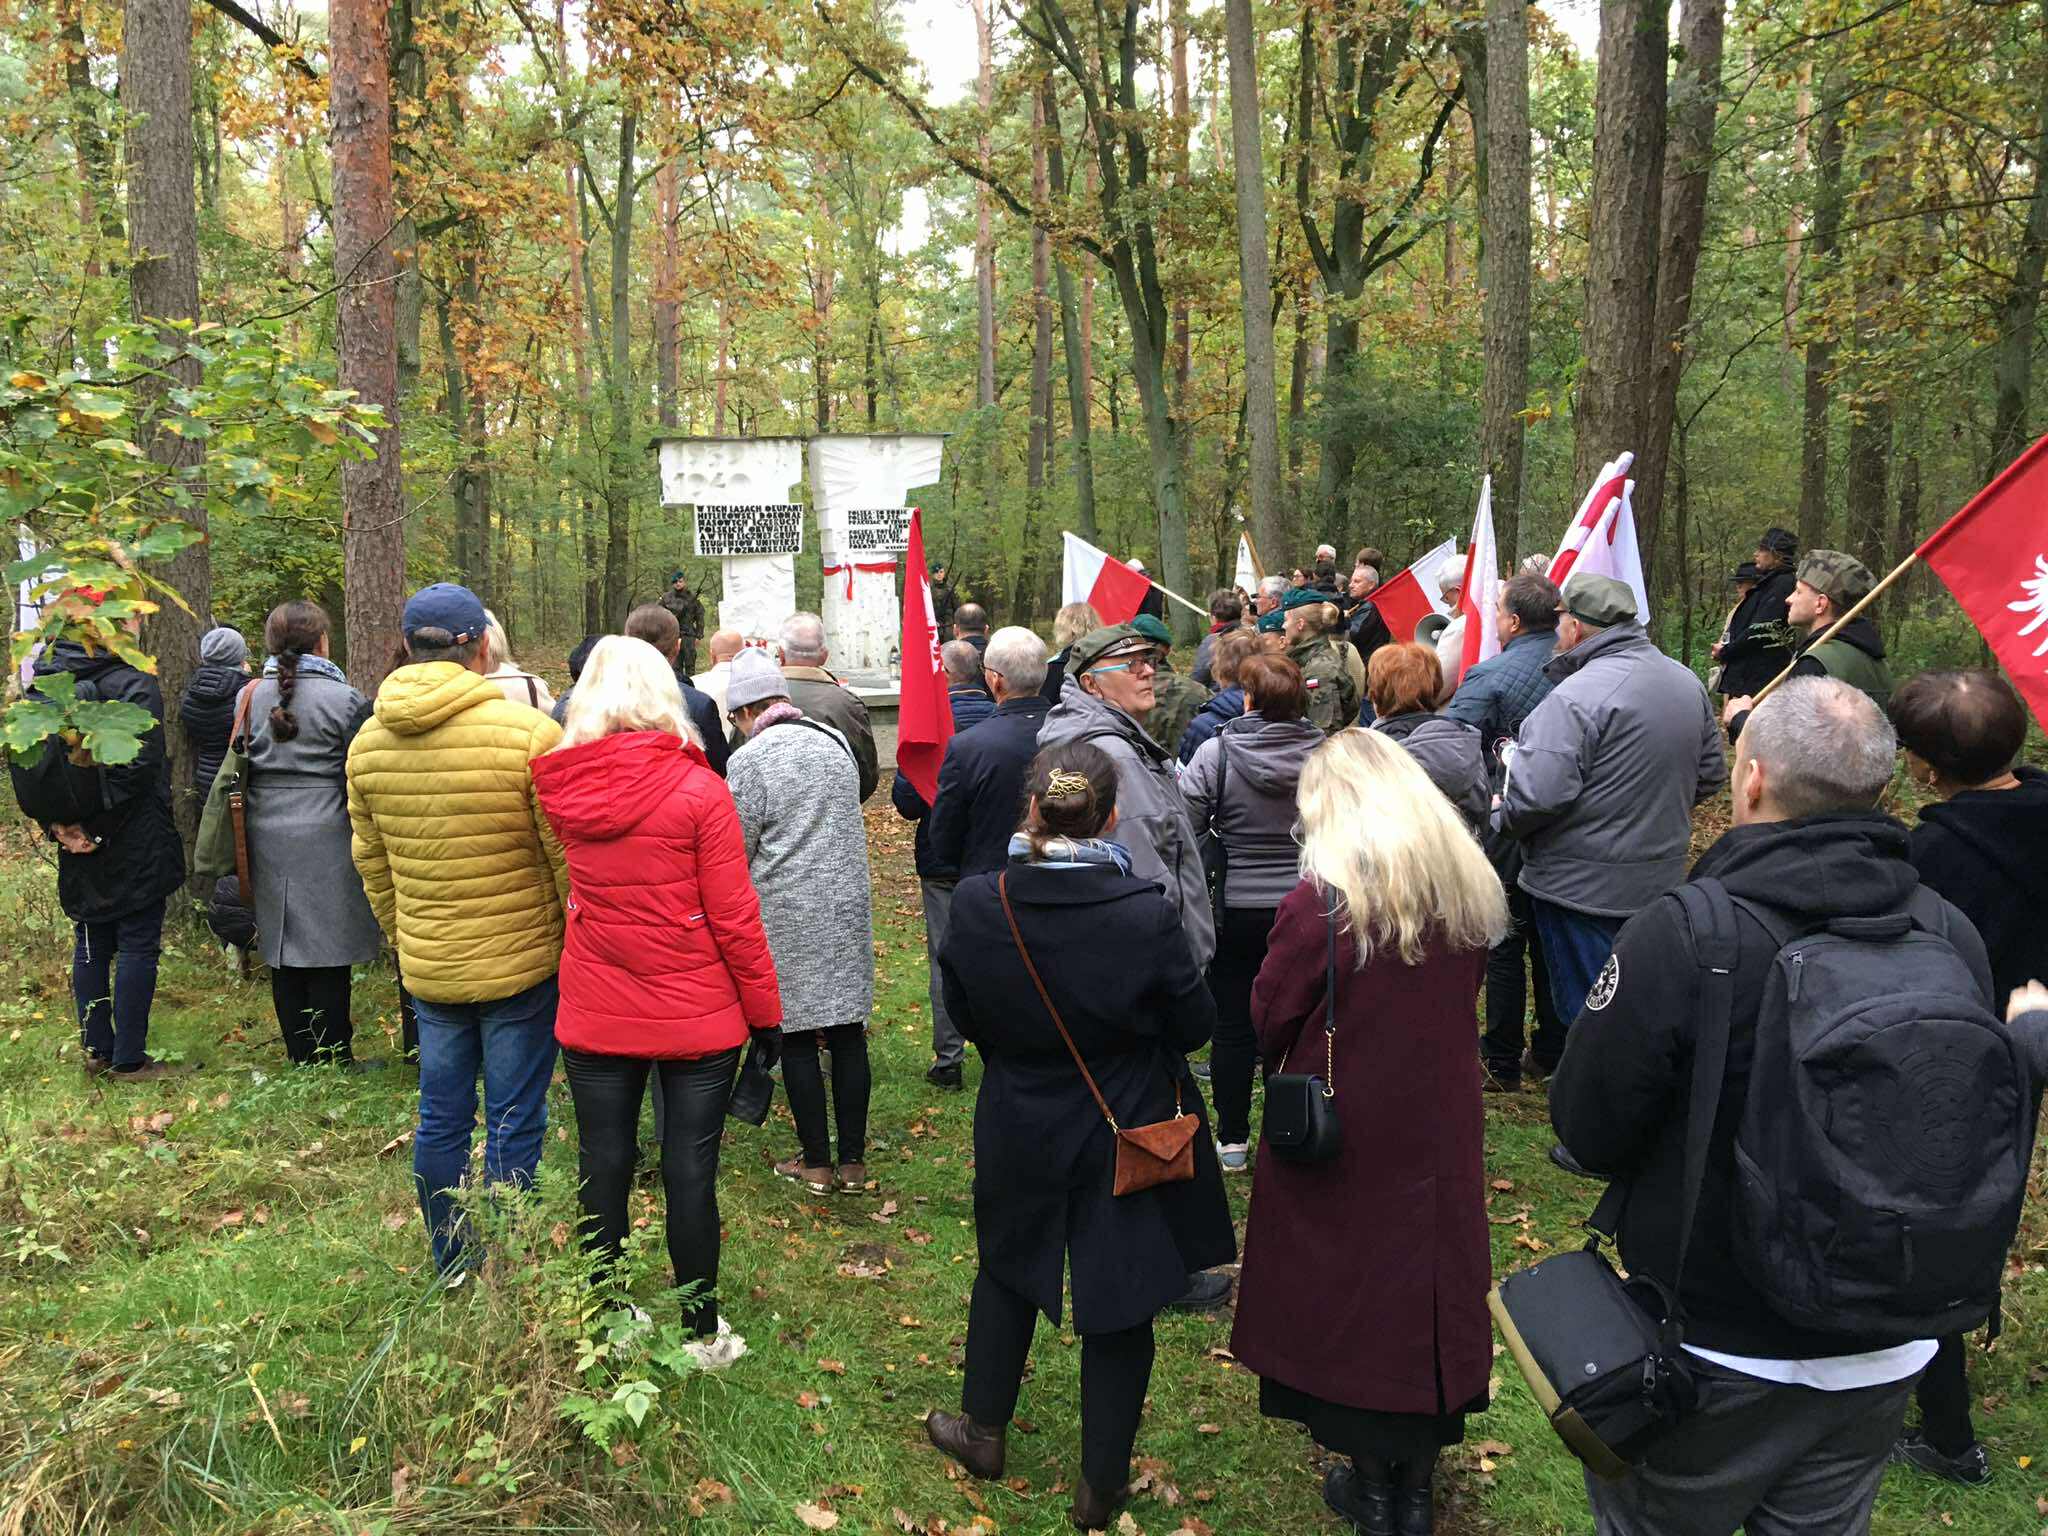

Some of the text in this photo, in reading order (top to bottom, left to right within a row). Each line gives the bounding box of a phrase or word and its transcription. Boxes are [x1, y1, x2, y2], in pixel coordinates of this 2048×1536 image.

[697, 512, 755, 520] HITLEROWSKI
[698, 519, 748, 527] MASOWYCH
[699, 526, 744, 534] POLSKICH
